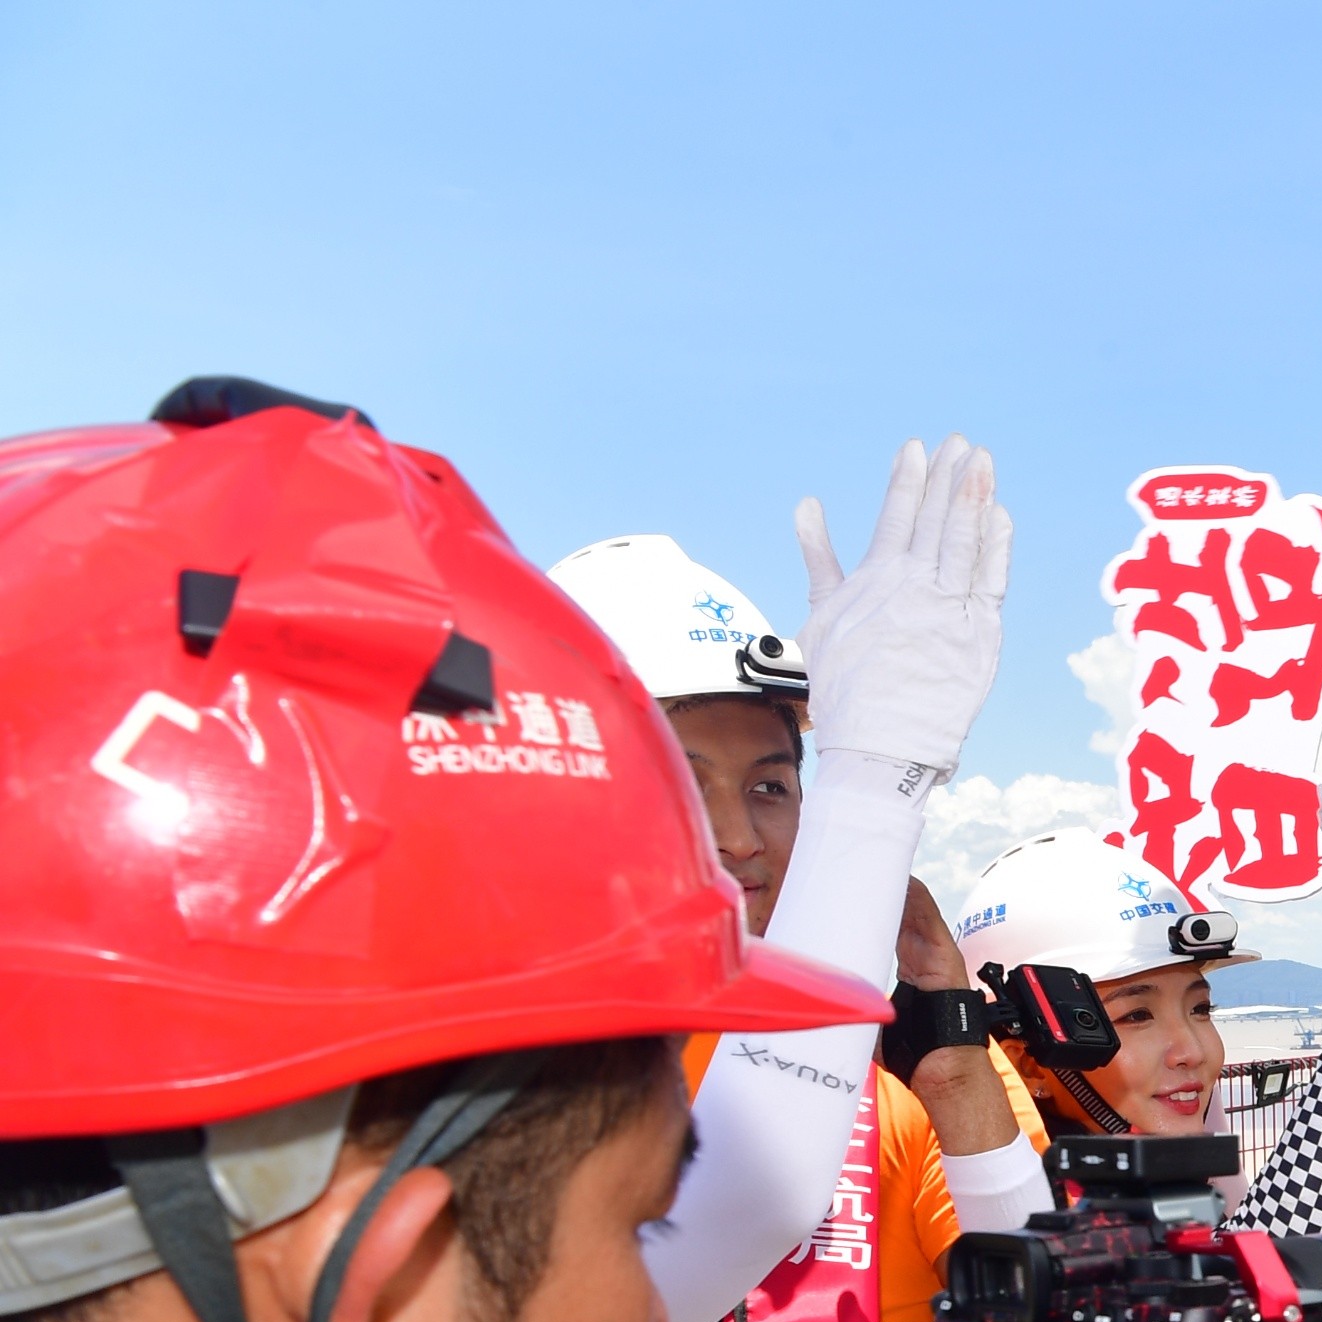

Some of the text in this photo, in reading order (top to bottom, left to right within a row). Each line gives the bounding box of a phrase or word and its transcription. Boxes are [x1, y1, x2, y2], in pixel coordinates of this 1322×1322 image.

[407, 744, 565, 777] SHENZHONG
[1119, 902, 1178, 921] 中国交建
